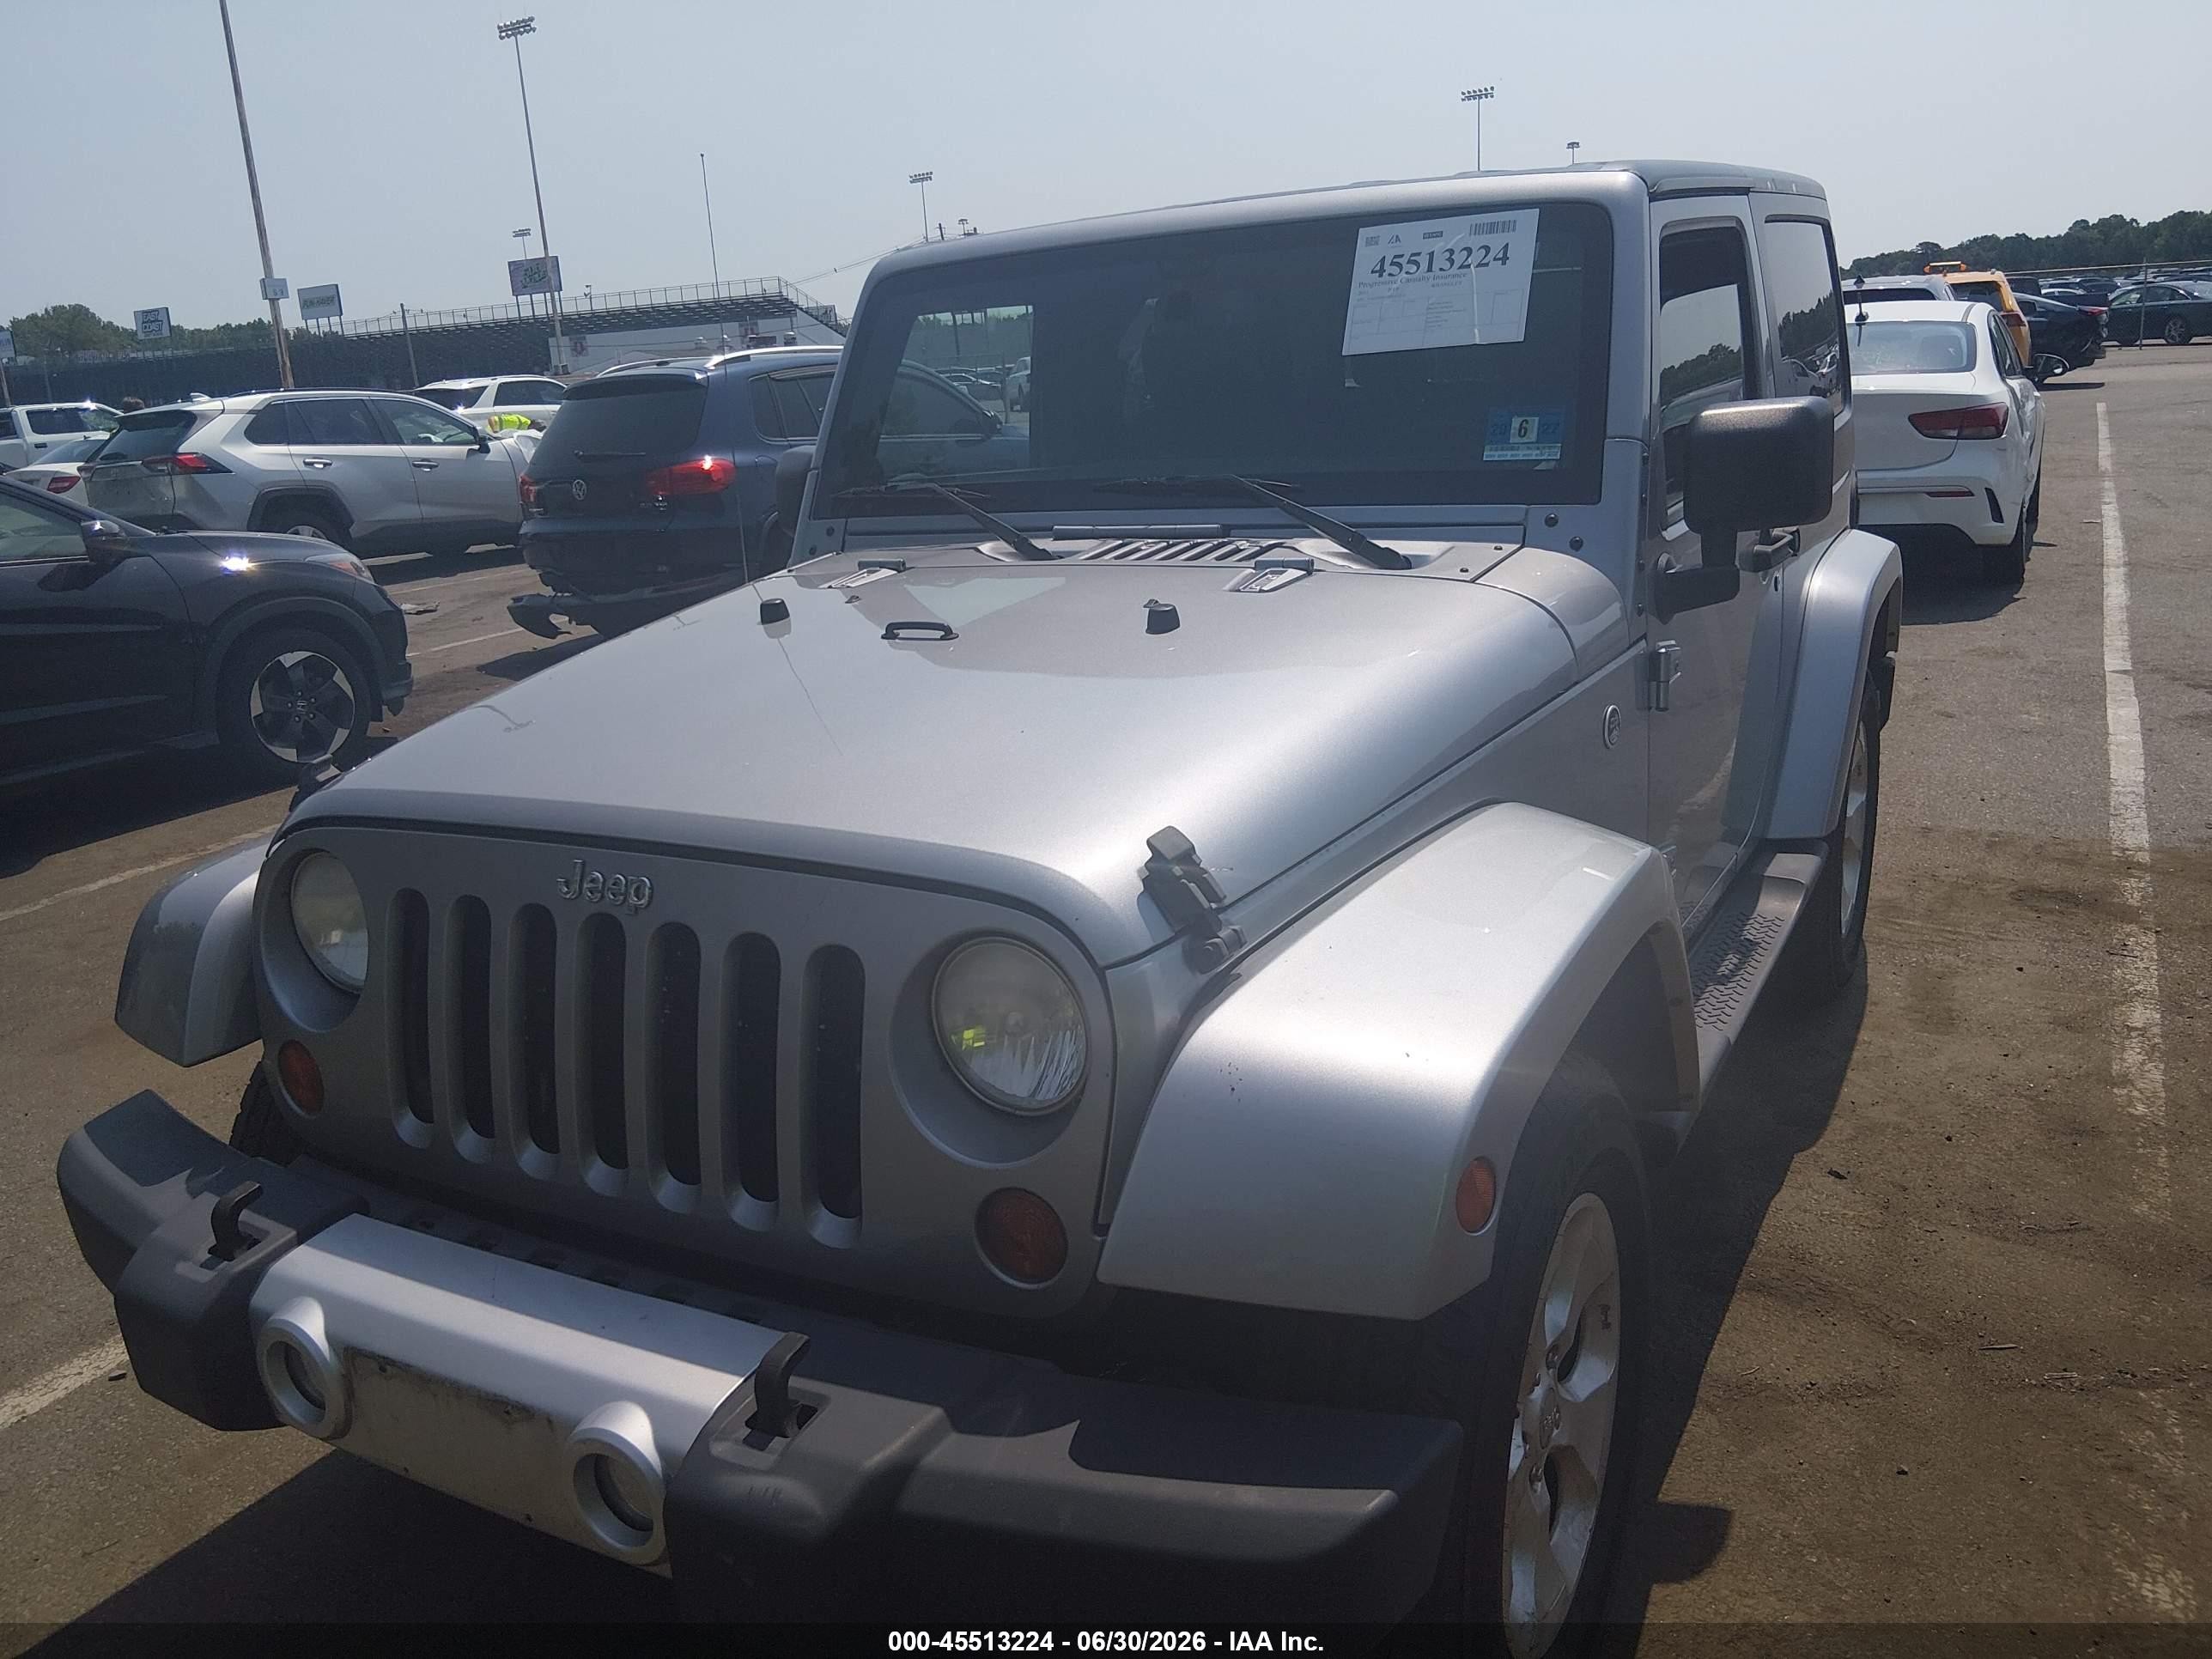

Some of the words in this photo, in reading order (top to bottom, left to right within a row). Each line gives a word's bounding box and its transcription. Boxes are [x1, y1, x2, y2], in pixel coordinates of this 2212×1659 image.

[1370, 242, 1510, 278] 45513224
[1433, 272, 1467, 282] Insurance
[143, 311, 160, 322] EAST
[1518, 419, 1528, 438] 6
[556, 859, 653, 915] Jeep
